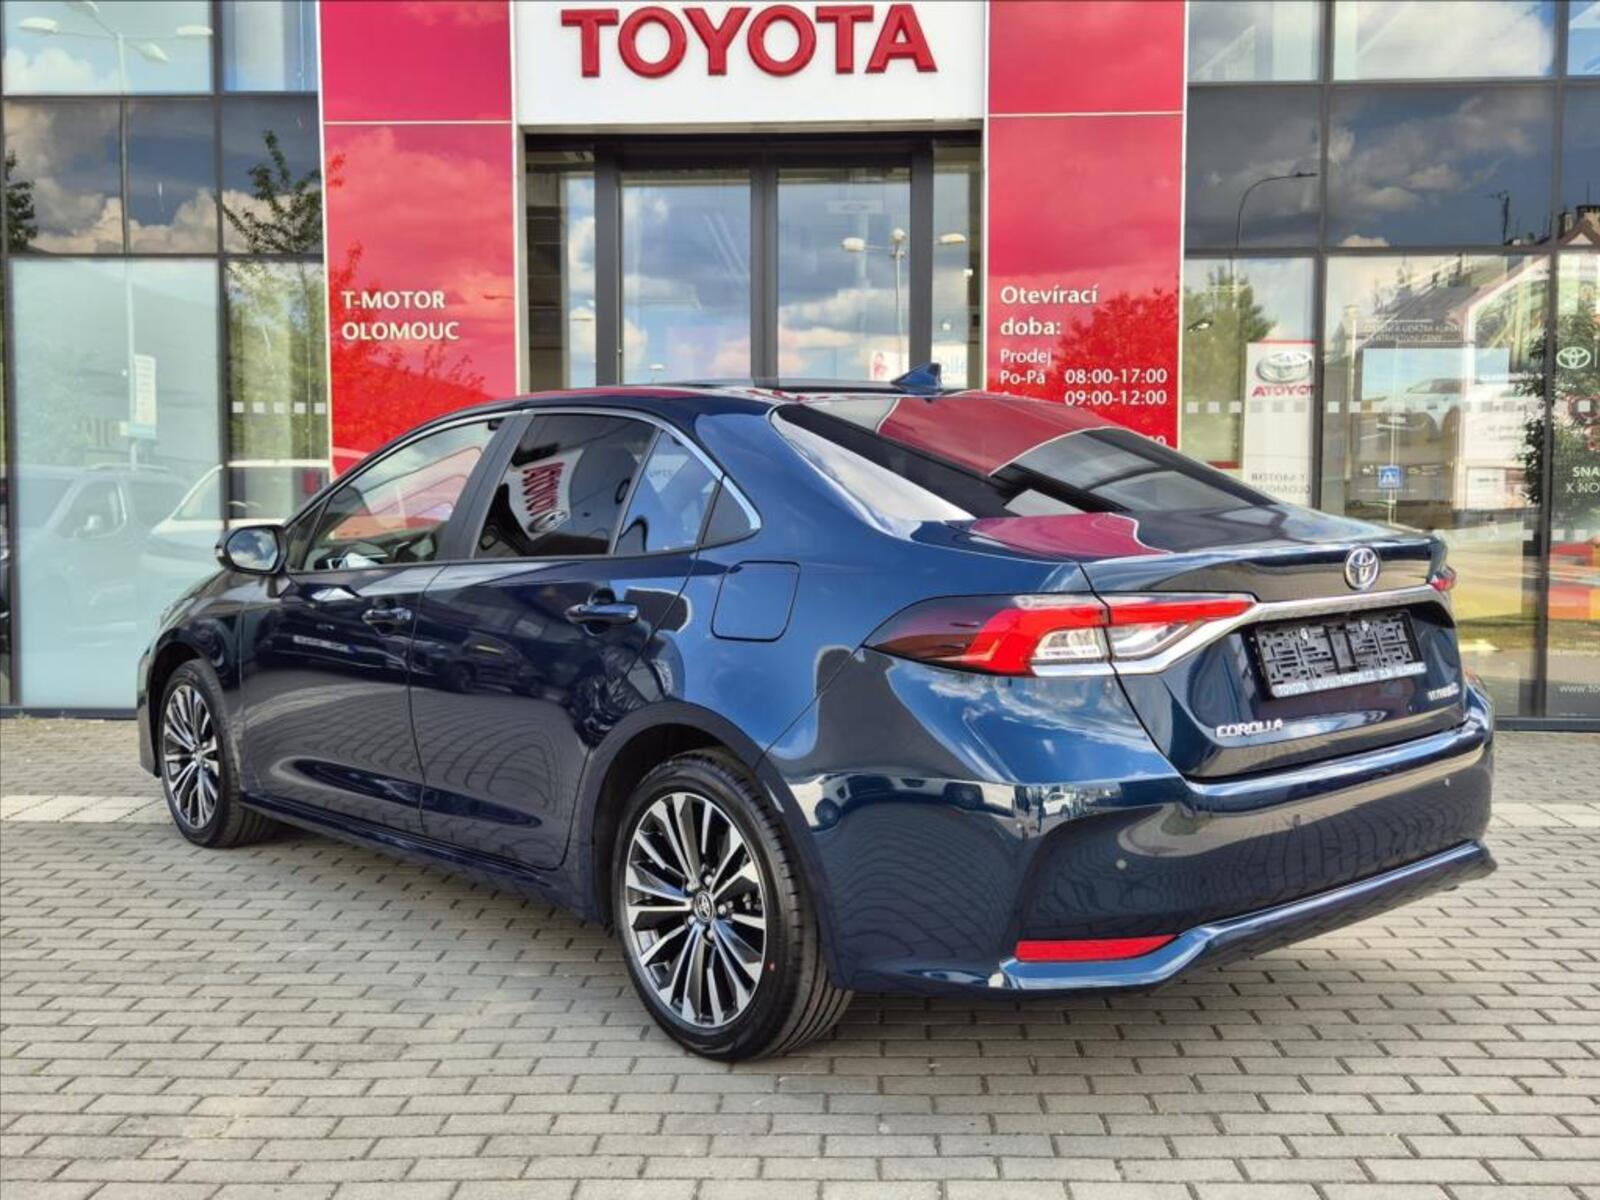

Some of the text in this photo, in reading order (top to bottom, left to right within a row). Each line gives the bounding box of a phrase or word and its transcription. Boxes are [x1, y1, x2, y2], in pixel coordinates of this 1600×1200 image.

[561, 4, 938, 78] TOYOTA
[340, 290, 446, 310] T-MOTOR
[1000, 283, 1099, 304] Otevírací
[341, 321, 460, 340] OLOMOUC
[1000, 317, 1061, 336] doba:
[1000, 348, 1052, 367] Prodej
[1000, 368, 1168, 385] Po-Pá 08:00-17:00
[1064, 390, 1168, 407] 09:00-12:00
[1216, 718, 1284, 738] COROLLA
